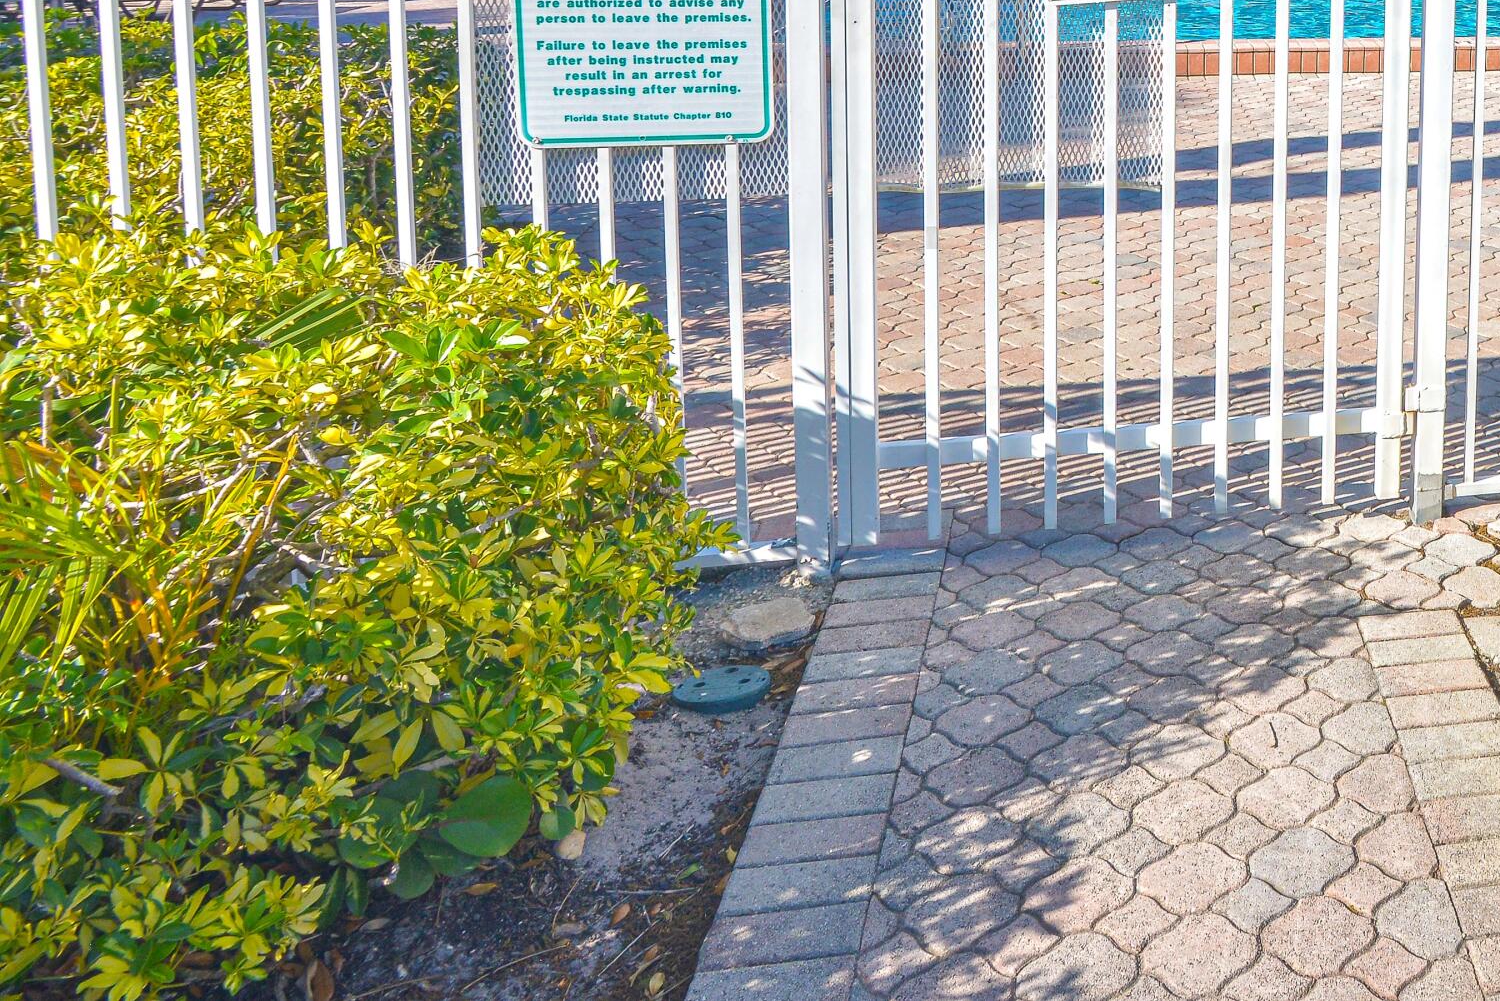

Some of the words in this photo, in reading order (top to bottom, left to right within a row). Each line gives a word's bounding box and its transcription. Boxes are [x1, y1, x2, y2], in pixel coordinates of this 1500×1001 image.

[649, 0, 662, 7] to
[721, 0, 744, 9] any
[536, 15, 585, 25] person
[592, 14, 606, 23] to
[612, 13, 650, 23] leave
[657, 13, 678, 23] the
[685, 13, 751, 24] premises.
[537, 40, 585, 50] Failure
[592, 41, 605, 50] to
[612, 40, 650, 49] leave
[657, 40, 678, 49] the
[685, 40, 747, 51] premises
[547, 55, 582, 65] after
[589, 55, 627, 66] being
[633, 55, 704, 64] instructed
[711, 56, 738, 66] may
[565, 70, 606, 80] result
[613, 70, 625, 80] in
[632, 72, 648, 80] an
[655, 70, 696, 79] arrest
[703, 69, 722, 78] for
[553, 86, 636, 97] trespassing
[643, 85, 677, 95] after
[683, 84, 741, 96] warning.
[564, 114, 597, 122] Florida
[674, 112, 711, 121] Chapter
